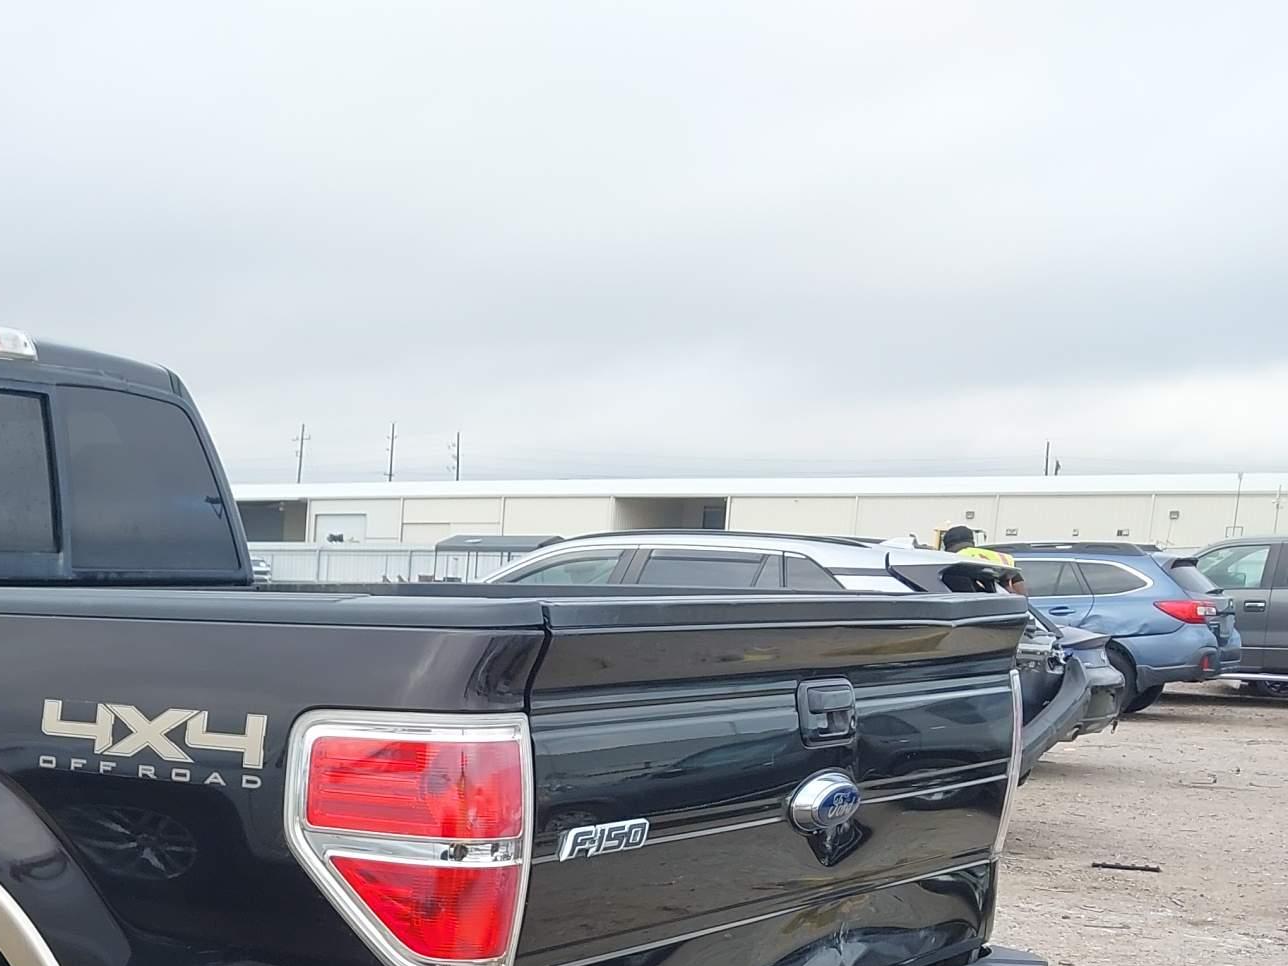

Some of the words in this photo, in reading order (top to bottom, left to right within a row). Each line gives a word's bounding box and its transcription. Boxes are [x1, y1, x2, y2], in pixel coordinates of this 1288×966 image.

[38, 755, 117, 775] OFF
[137, 764, 262, 789] ROAD
[827, 792, 857, 818] Ford
